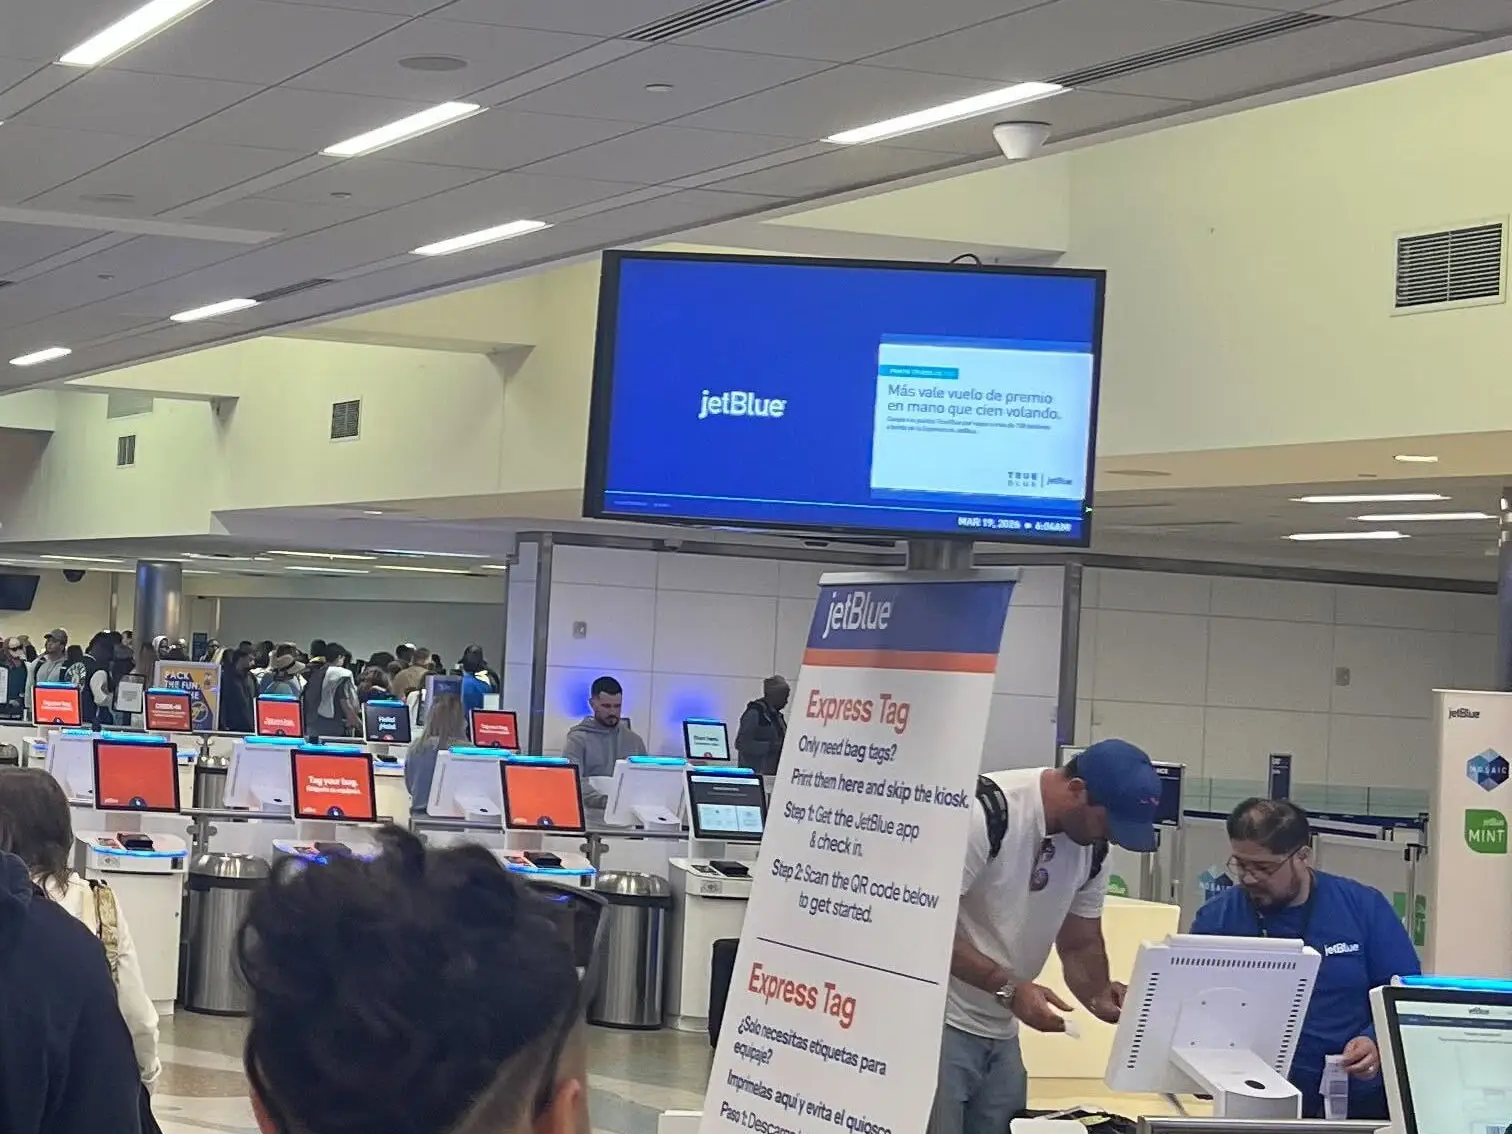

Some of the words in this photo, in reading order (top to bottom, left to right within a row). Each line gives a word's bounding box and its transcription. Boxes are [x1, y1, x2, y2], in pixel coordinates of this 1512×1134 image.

[697, 389, 786, 420] jetBlue
[888, 384, 916, 397] Más
[918, 387, 945, 399] vale
[948, 388, 983, 401] vuelo
[986, 389, 1003, 402] de
[1005, 392, 1053, 405] premio
[887, 402, 904, 412] en
[907, 403, 945, 414] mano
[948, 405, 973, 417] que
[976, 405, 1003, 417] cien
[1007, 407, 1061, 420] volando.
[822, 590, 892, 639] jetBlue
[164, 671, 190, 680] PACK
[806, 689, 873, 727] Express
[879, 693, 910, 734] Tag
[1448, 707, 1481, 719] jetBlue
[798, 735, 820, 758] Only
[820, 738, 842, 756] need
[844, 739, 865, 762] bag
[868, 743, 898, 765] tags?
[1469, 765, 1508, 775] MOSAIC
[791, 768, 814, 787] Print
[814, 771, 837, 790] them
[838, 774, 864, 794] here
[865, 778, 887, 797] and
[886, 781, 911, 804] skip
[914, 784, 933, 803] the
[934, 785, 970, 809] kiosk.
[783, 801, 806, 824] Step
[807, 804, 815, 822] 1:
[815, 805, 832, 825] Get
[833, 808, 857, 828] the
[855, 811, 895, 835] JetBlue
[896, 822, 920, 843] app
[1468, 829, 1505, 844] MINT
[809, 831, 817, 848] &
[817, 832, 850, 855] check
[851, 837, 864, 857] in.
[771, 858, 794, 883] Step
[794, 862, 803, 881] 2:
[803, 864, 829, 887] Scan
[831, 871, 849, 891] the
[850, 873, 869, 895] QR
[869, 881, 900, 901] code
[902, 884, 940, 909] below
[798, 890, 809, 909] to
[809, 897, 832, 916] get
[832, 900, 873, 923] started.
[1324, 942, 1360, 957] jetBlue
[747, 962, 819, 1010] Express
[823, 982, 857, 1030] Tag
[733, 1040, 774, 1066] equipaje?
[737, 1014, 762, 1035] ¿Solo
[762, 1025, 809, 1052] necesitas
[809, 1038, 859, 1067] etiquetas
[859, 1054, 887, 1076] para
[719, 1100, 742, 1125] Paso
[741, 1109, 748, 1127] 1:
[774, 1089, 801, 1111] aquí
[798, 1098, 806, 1116] y
[806, 1101, 833, 1122] evita
[833, 1108, 846, 1126] el
